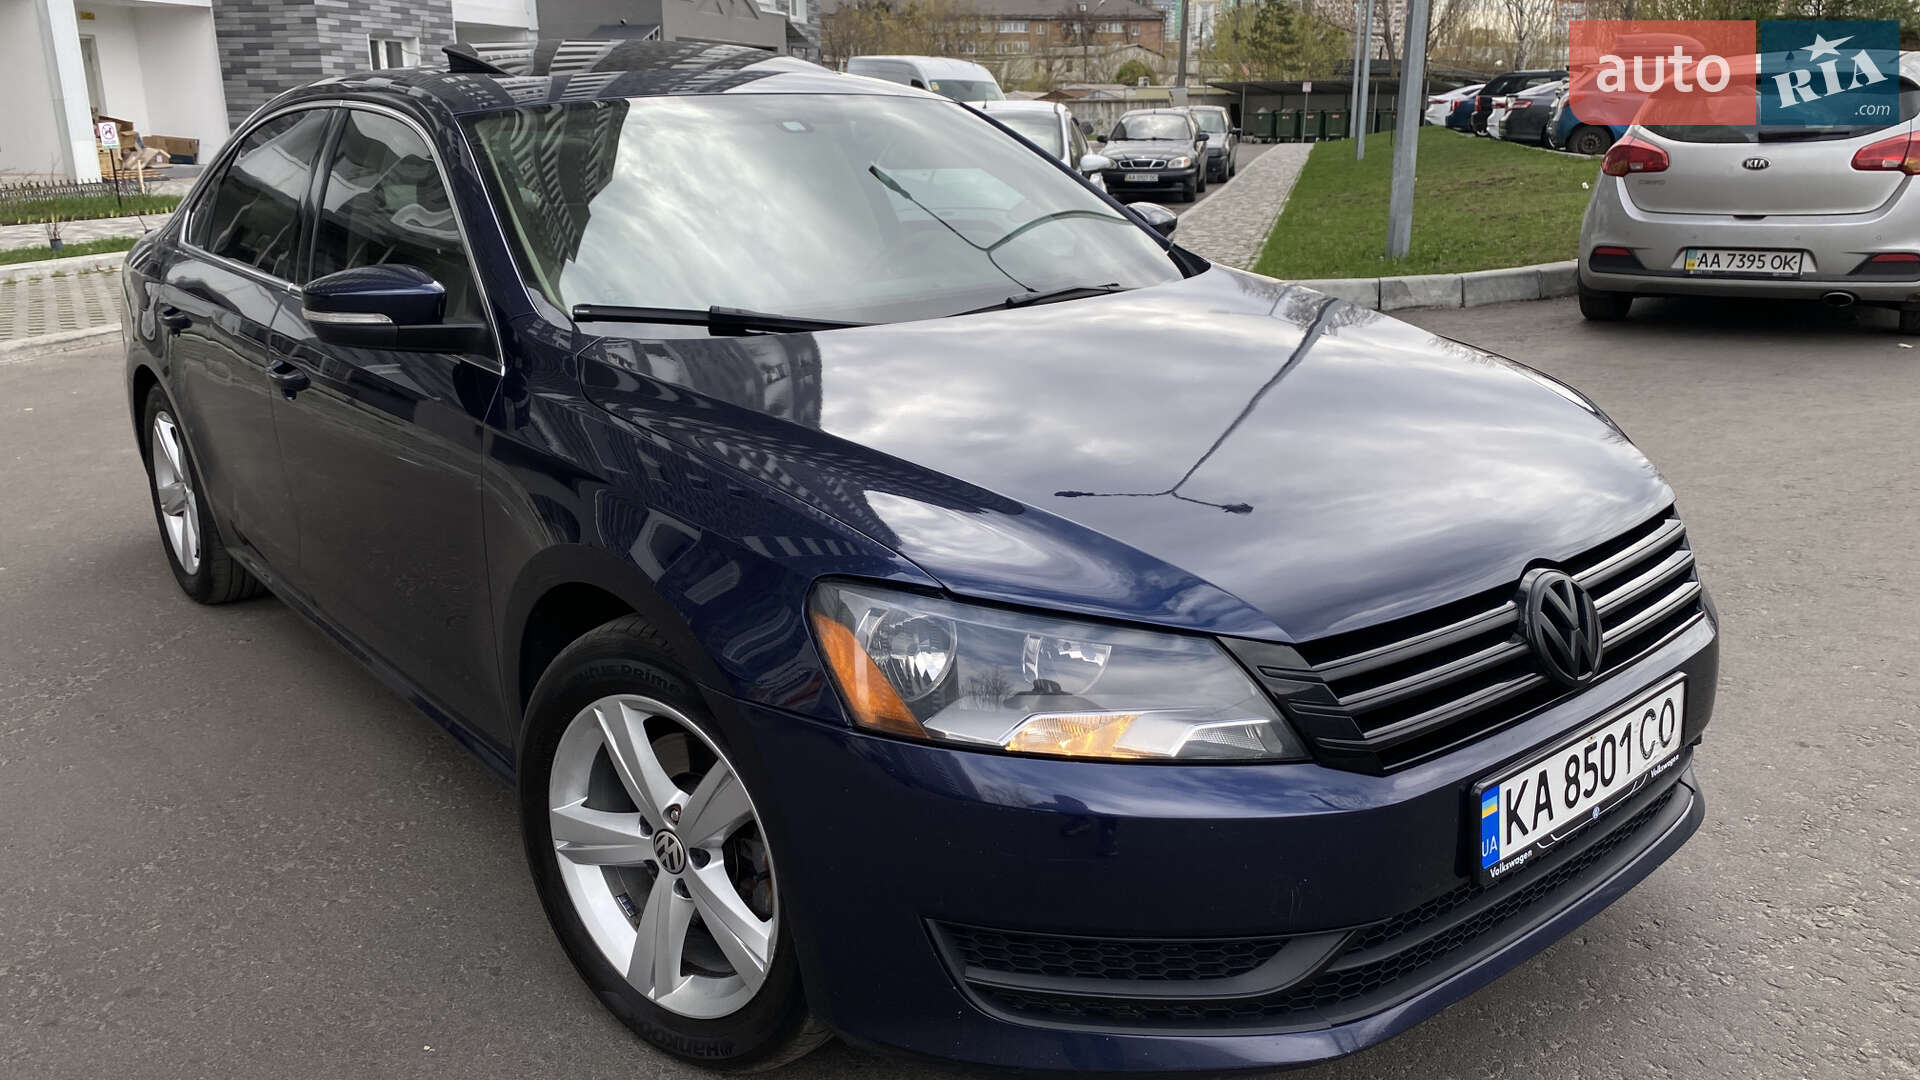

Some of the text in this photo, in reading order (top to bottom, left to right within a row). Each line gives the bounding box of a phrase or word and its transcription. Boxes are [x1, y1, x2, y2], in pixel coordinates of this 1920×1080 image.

[1745, 159, 1767, 168] KIA
[1697, 253, 1797, 271] AA 7395 OK
[1506, 697, 1675, 846] KA 8501 CO
[1481, 835, 1498, 857] UA
[1489, 849, 1533, 878] Volkswagen
